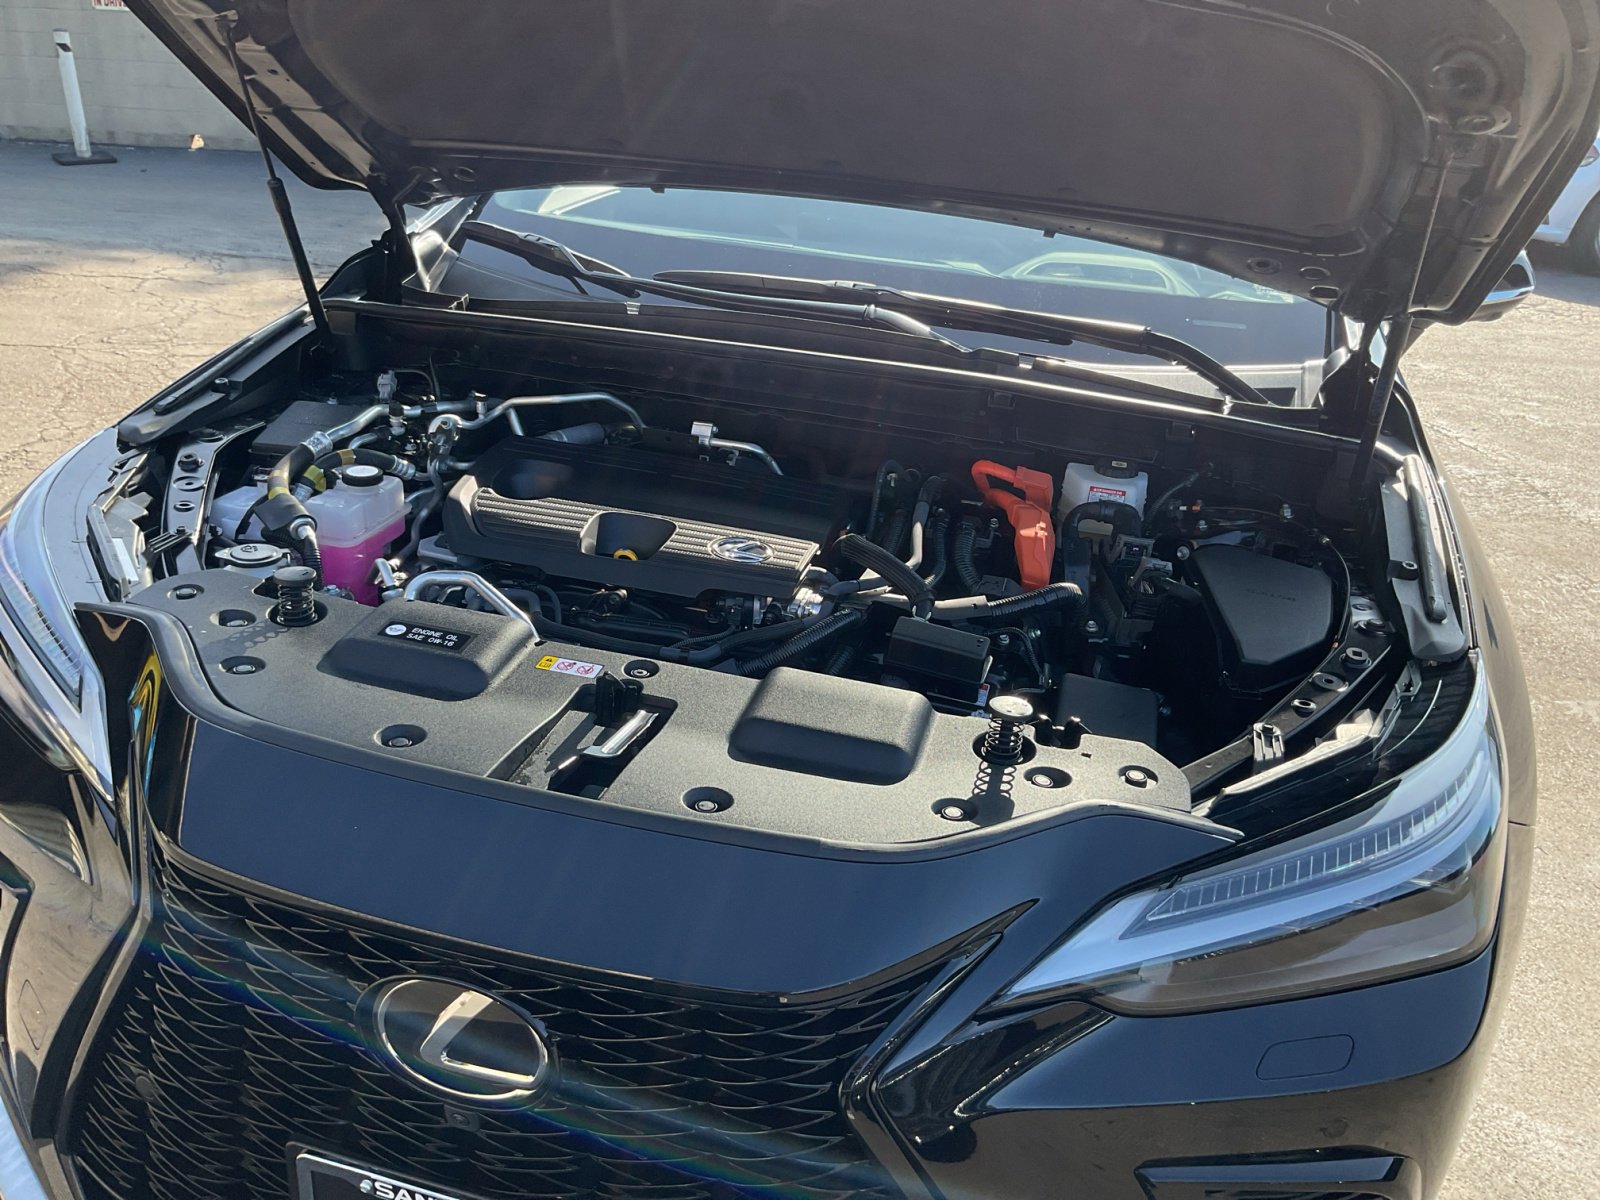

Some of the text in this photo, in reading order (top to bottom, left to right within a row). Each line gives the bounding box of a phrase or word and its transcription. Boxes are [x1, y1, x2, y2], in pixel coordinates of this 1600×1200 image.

[412, 628, 443, 638] ENGINE
[406, 633, 454, 647] SAE 0W-16
